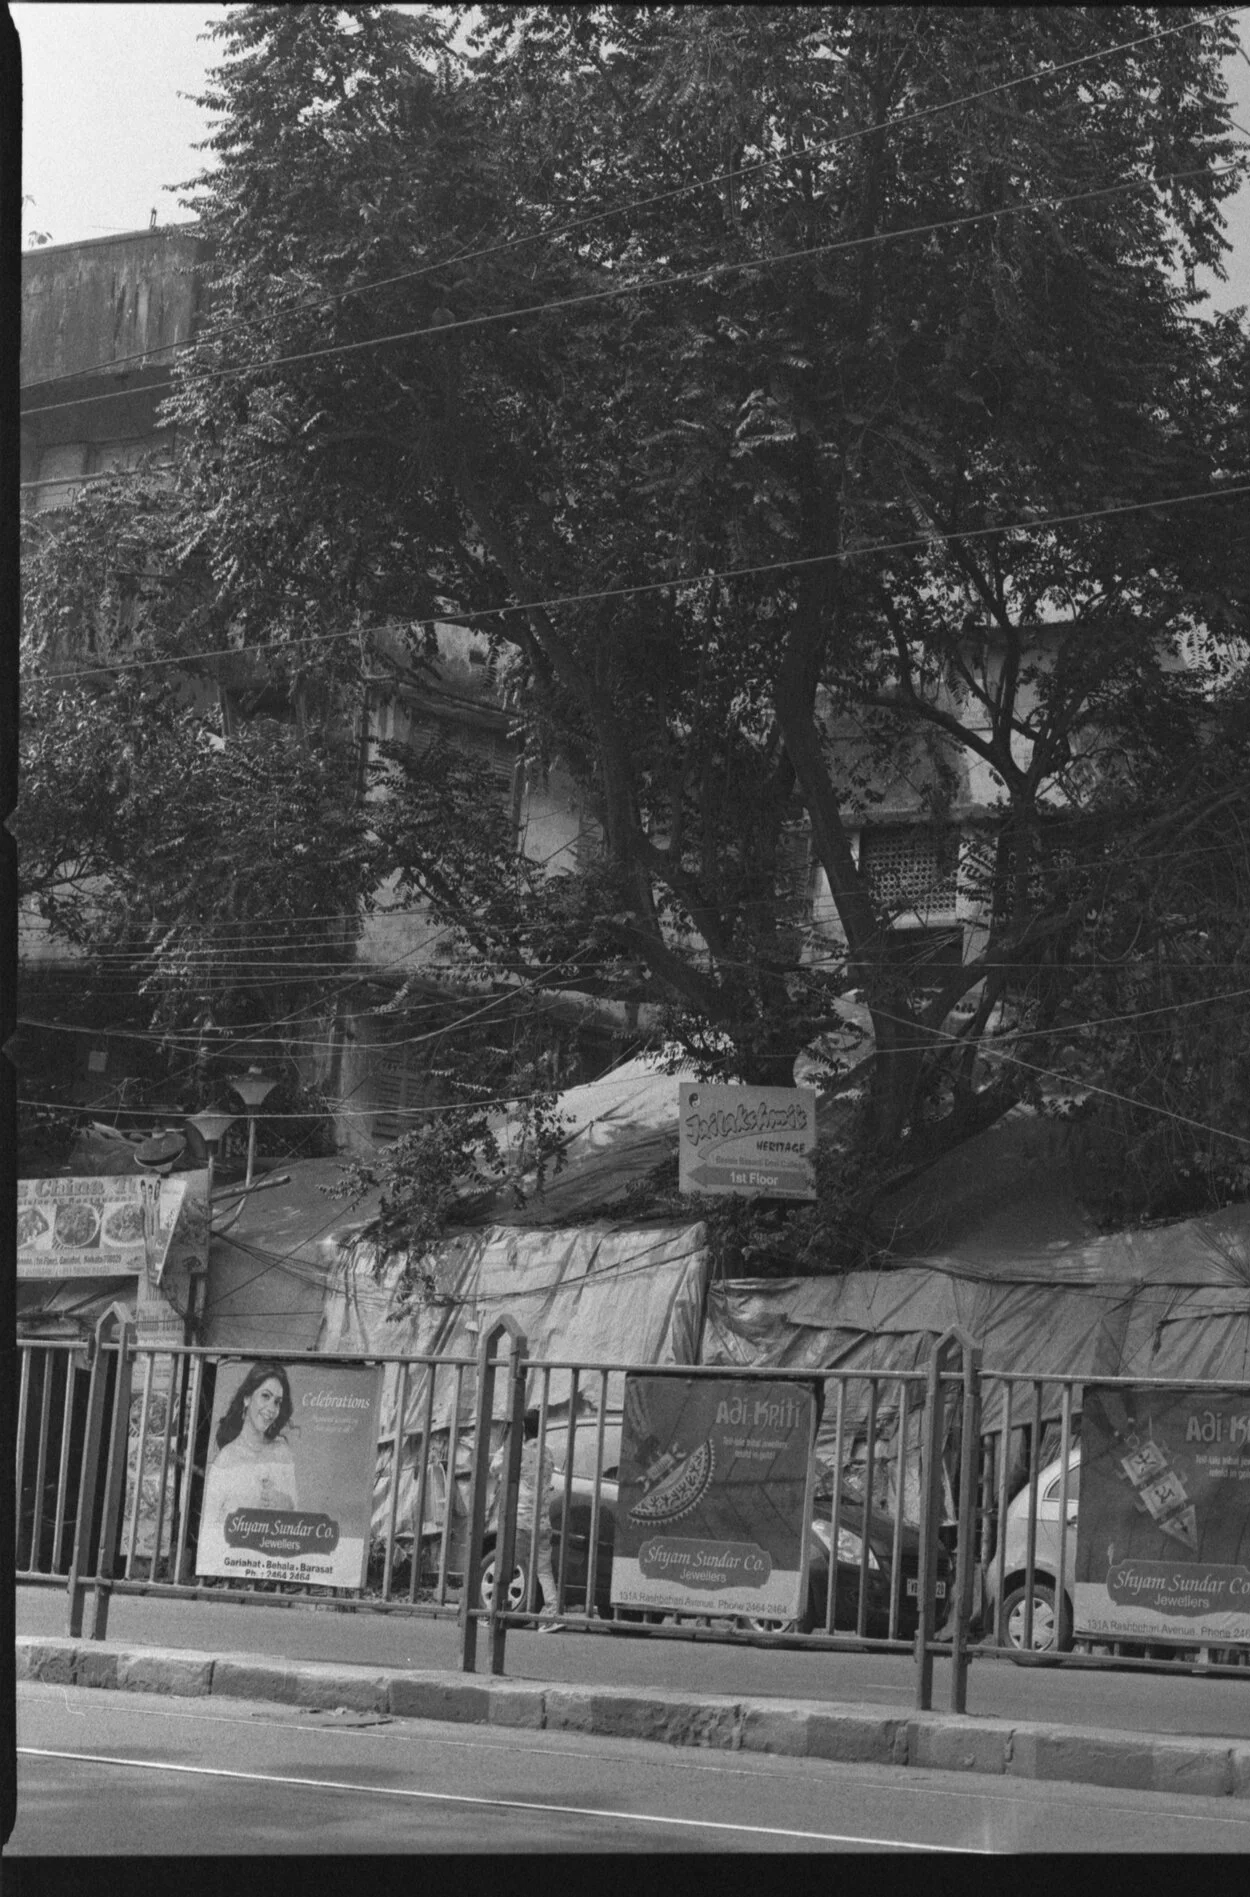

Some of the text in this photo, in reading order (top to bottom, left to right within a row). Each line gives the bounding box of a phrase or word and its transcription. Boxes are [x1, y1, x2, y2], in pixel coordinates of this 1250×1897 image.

[756, 1140, 806, 1154] HERITAGE
[730, 1171, 779, 1186] 1st Floor
[35, 1178, 105, 1199] China
[302, 1390, 371, 1410] Celebrations
[228, 1514, 335, 1540] Shyam Sundar Co.
[258, 1537, 301, 1551] Jewellers
[223, 1556, 334, 1575] Gariahat Behala Barasat
[644, 1545, 765, 1571] Shyam Sundar Co.
[266, 1569, 287, 1580] 2464
[679, 1568, 727, 1584] Jewellers
[1113, 1568, 1167, 1596] Shyam
[1167, 1572, 1226, 1594] Sundar
[1153, 1592, 1210, 1609] Jewellers
[1201, 1626, 1231, 1639] Phone
